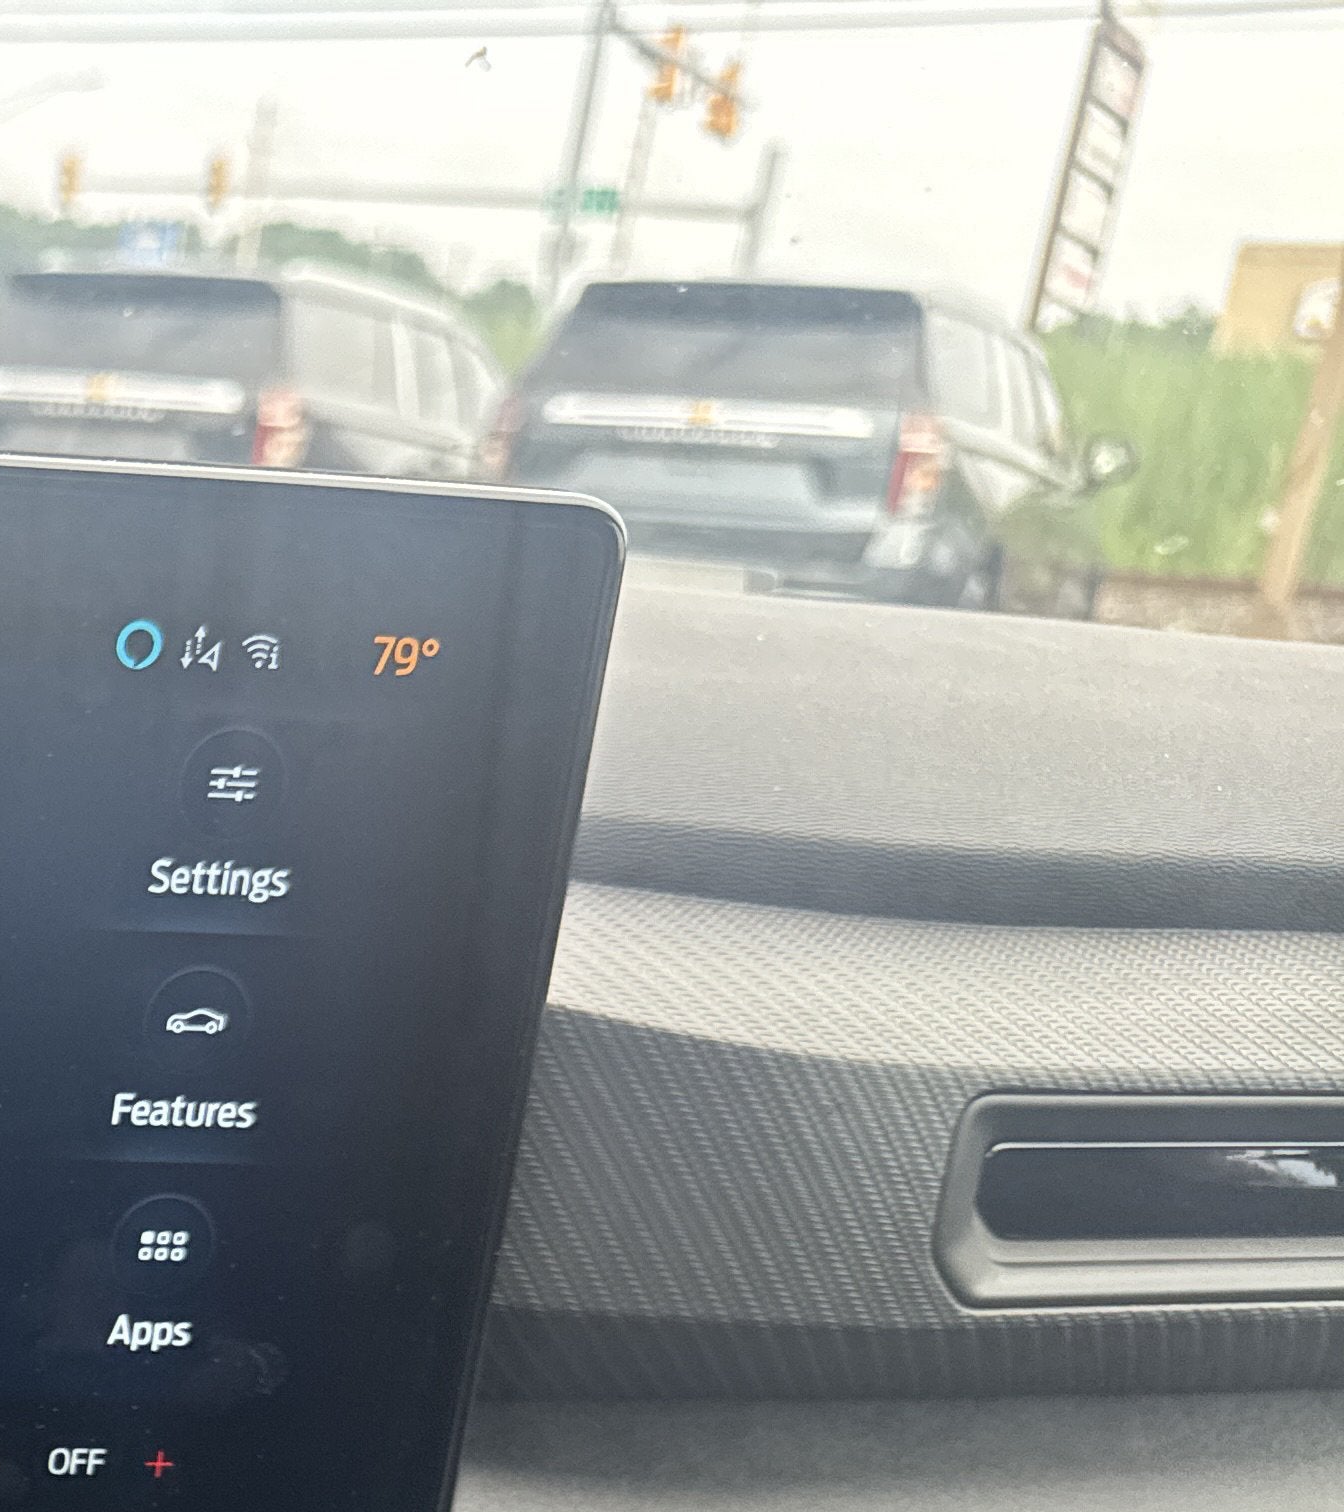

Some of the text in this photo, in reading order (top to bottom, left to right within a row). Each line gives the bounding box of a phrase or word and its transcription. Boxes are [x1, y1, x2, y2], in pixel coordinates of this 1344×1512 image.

[372, 634, 442, 676] 79°
[147, 856, 293, 904] Settings
[110, 1091, 259, 1129] Features
[106, 1313, 194, 1352] Apps
[46, 1447, 107, 1477] OFF
